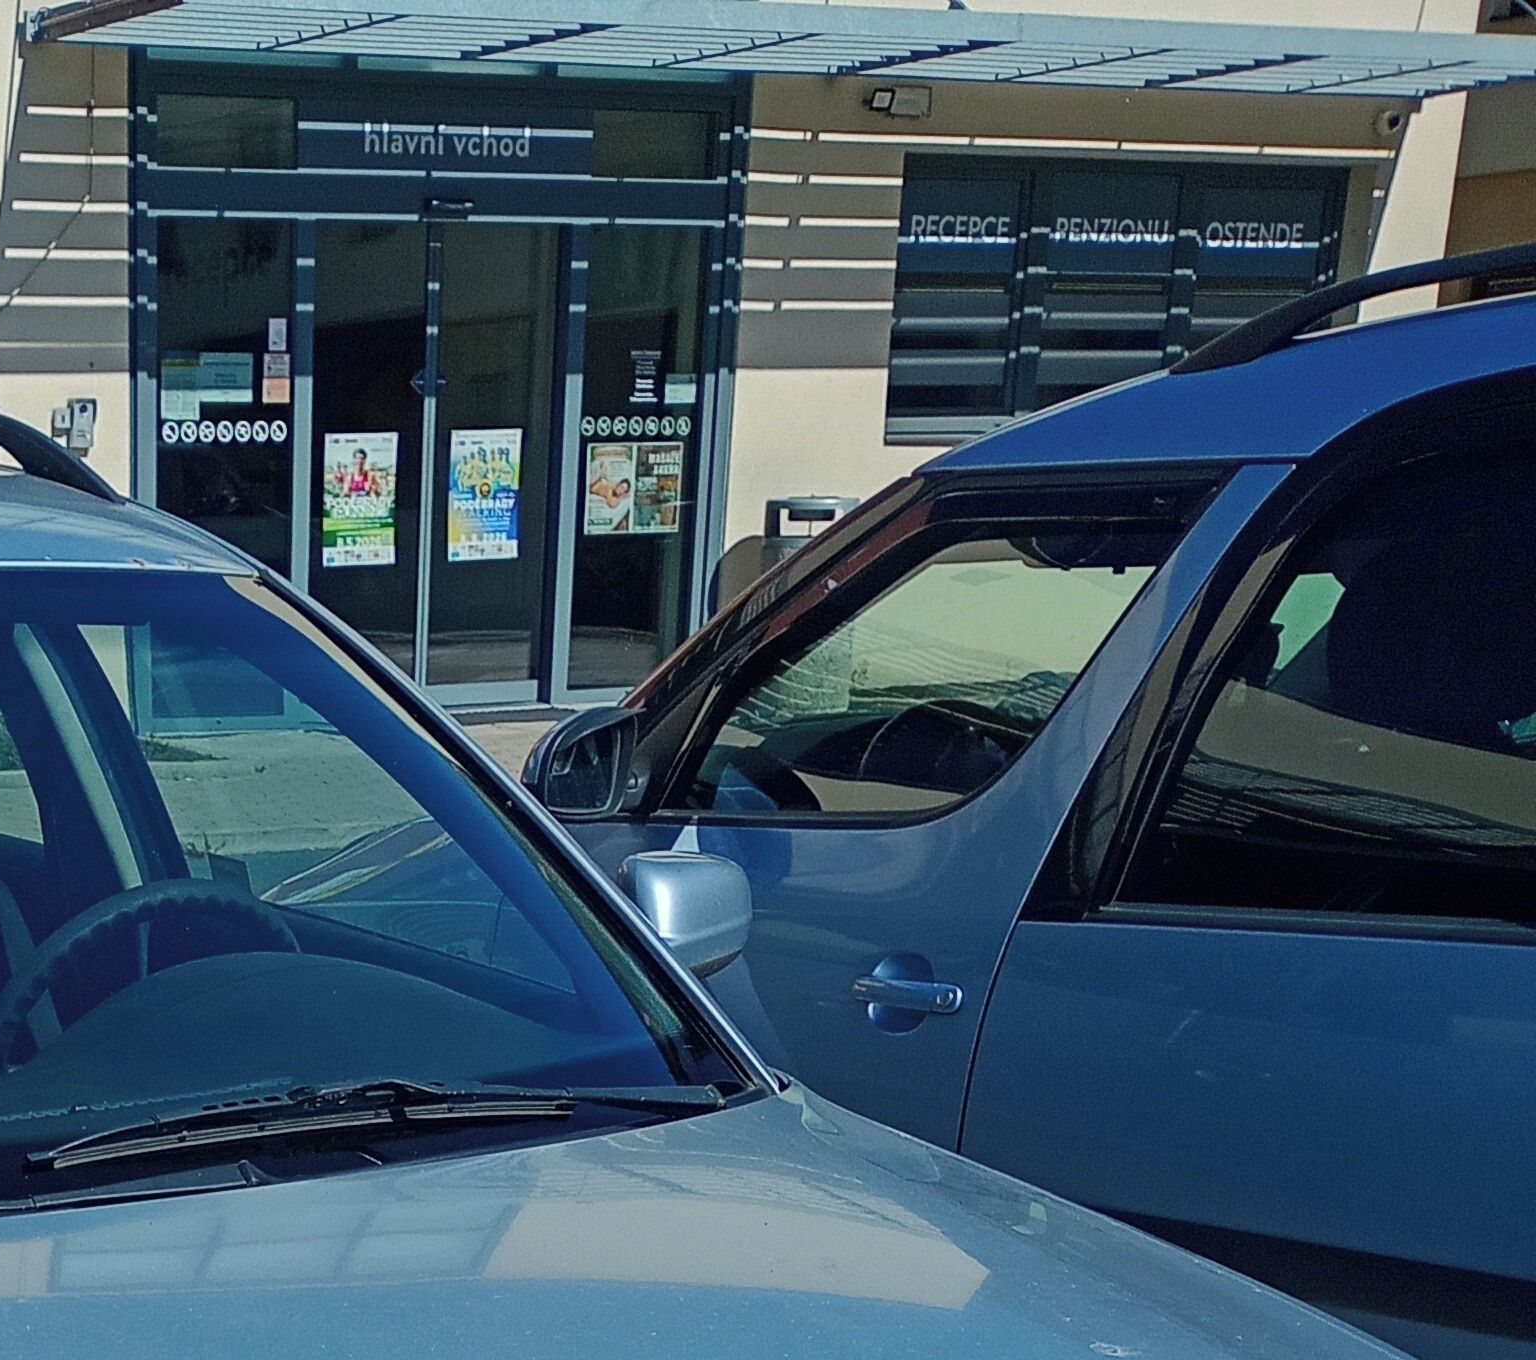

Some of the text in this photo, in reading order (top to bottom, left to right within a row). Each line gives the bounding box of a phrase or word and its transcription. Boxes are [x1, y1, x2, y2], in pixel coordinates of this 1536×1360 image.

[453, 125, 531, 157] vchod
[910, 214, 1305, 248] RECEPCE PENZIONU OSTENDE
